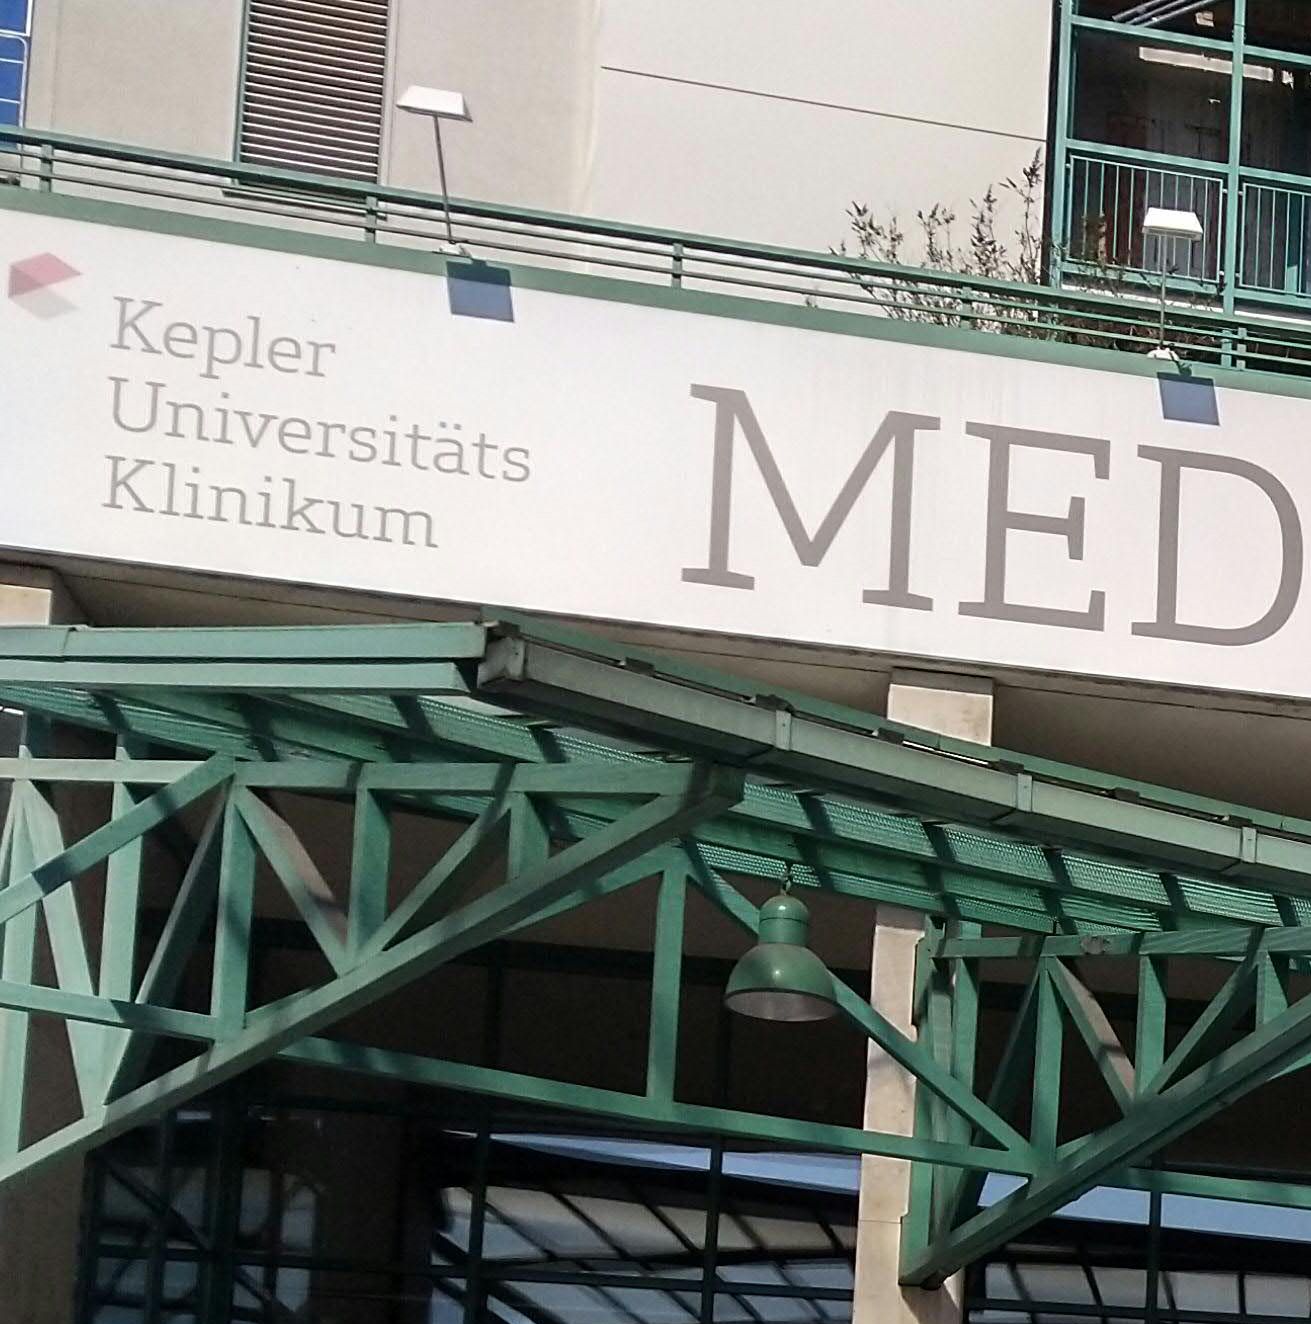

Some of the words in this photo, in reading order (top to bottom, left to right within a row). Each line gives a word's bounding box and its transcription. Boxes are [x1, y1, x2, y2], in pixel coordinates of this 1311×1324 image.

[109, 295, 337, 380] Kepler
[107, 375, 531, 483] Universitäts
[101, 454, 439, 549] Klinikum
[680, 382, 1303, 647] MED
